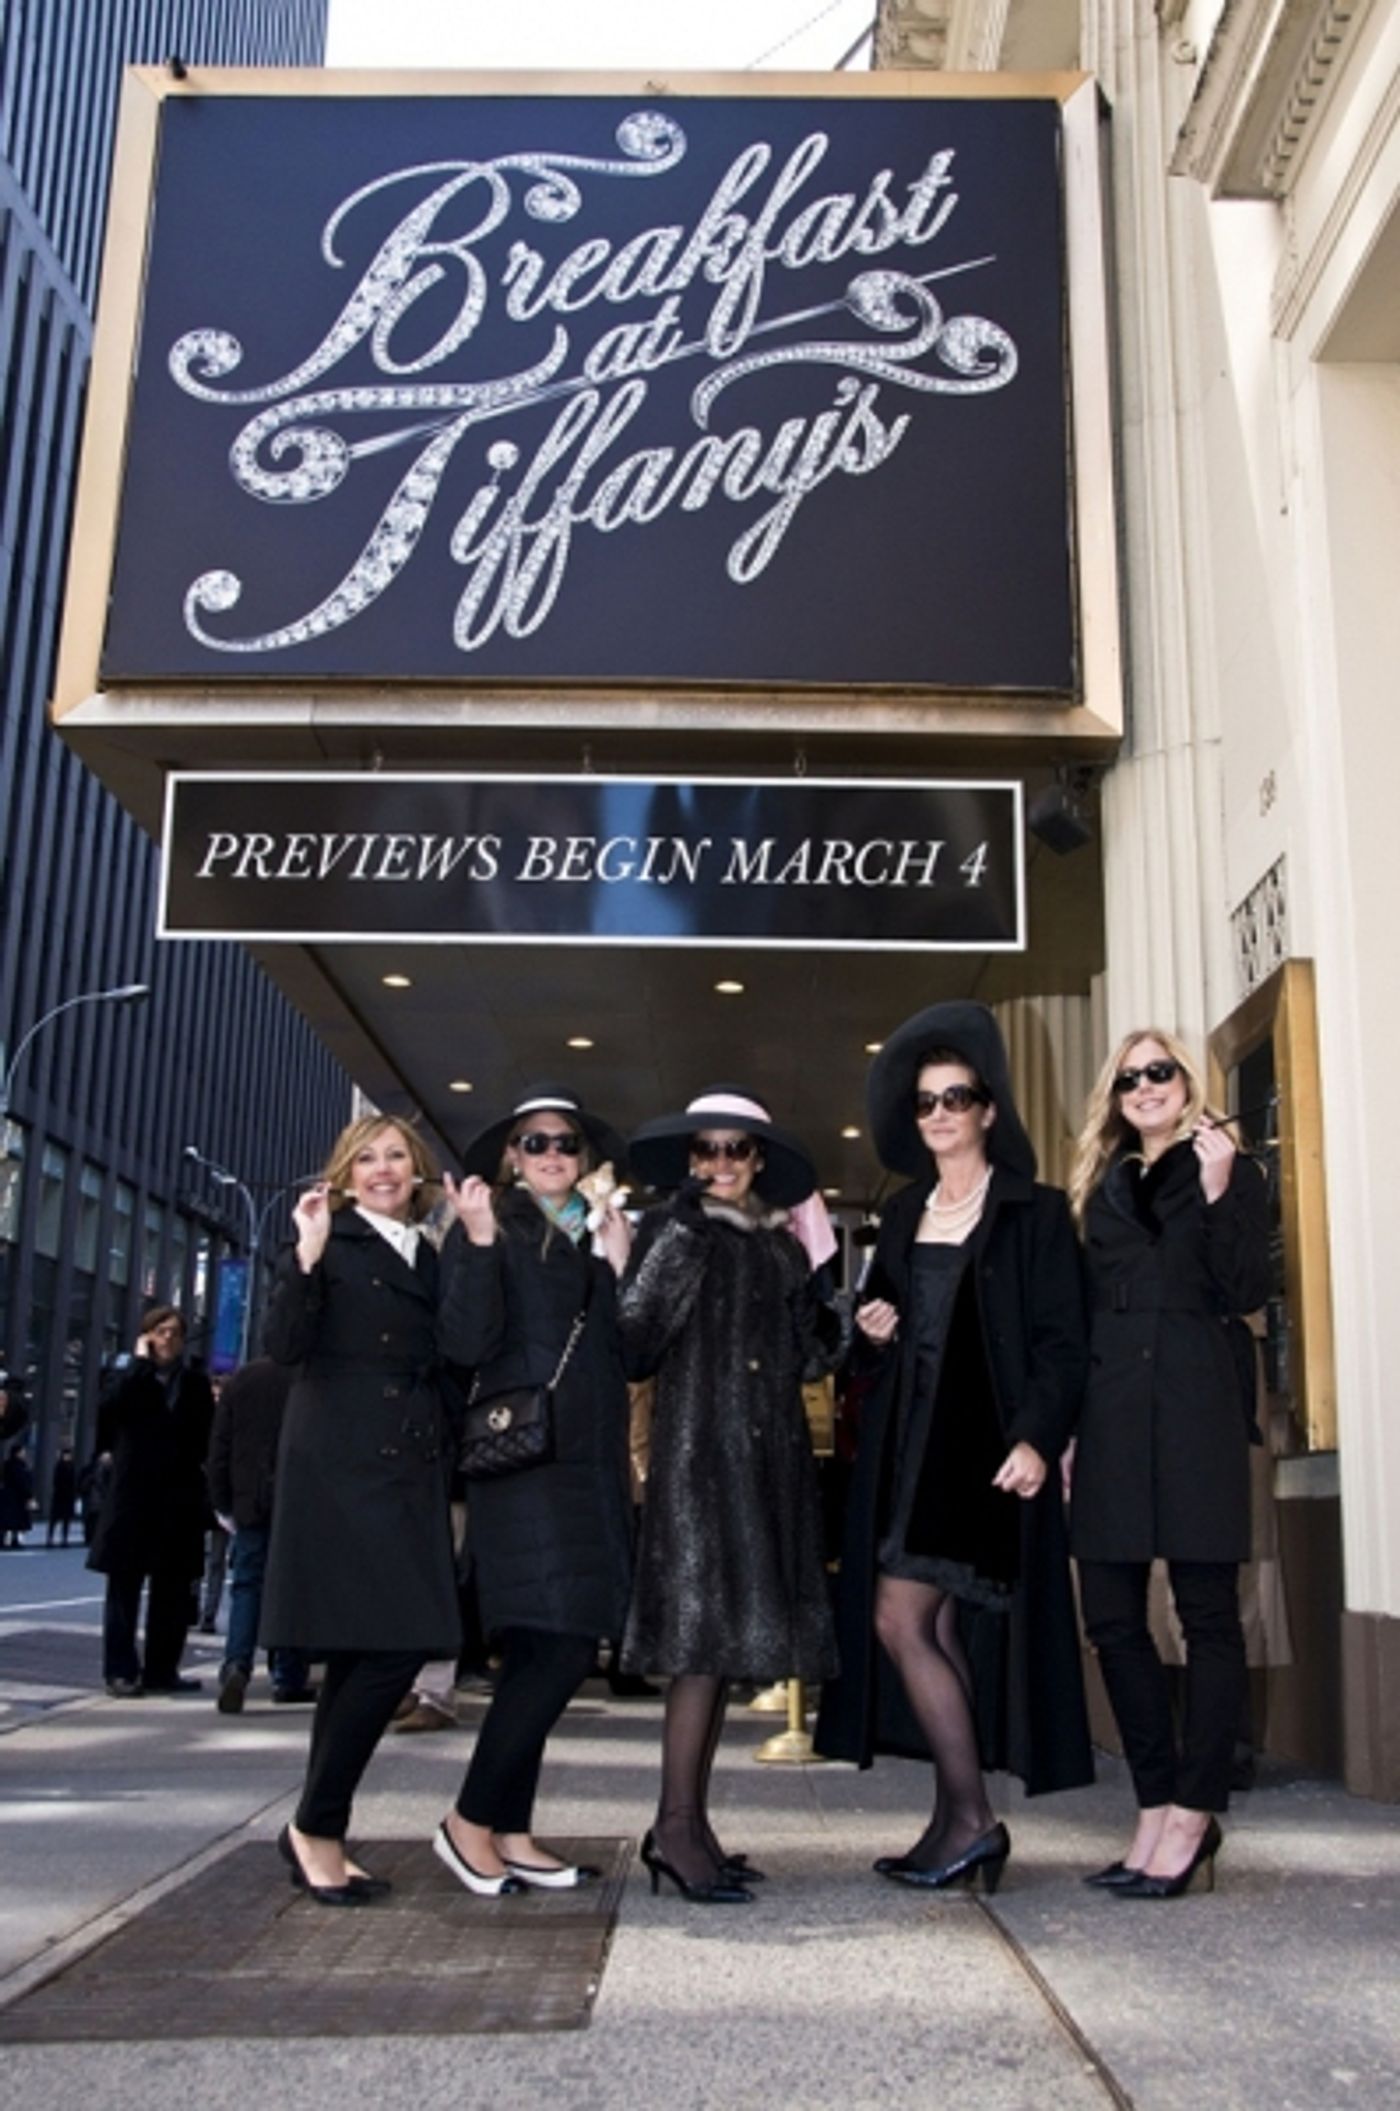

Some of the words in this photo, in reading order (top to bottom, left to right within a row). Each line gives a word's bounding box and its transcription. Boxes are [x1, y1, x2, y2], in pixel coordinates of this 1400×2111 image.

[168, 111, 958, 404] Breakfast
[584, 295, 682, 381] at
[183, 325, 912, 652] Tiffany's
[197, 832, 504, 884] PREVIEWS
[516, 836, 714, 886] BEGIN
[721, 838, 948, 888] MARCH
[960, 841, 990, 889] 4
